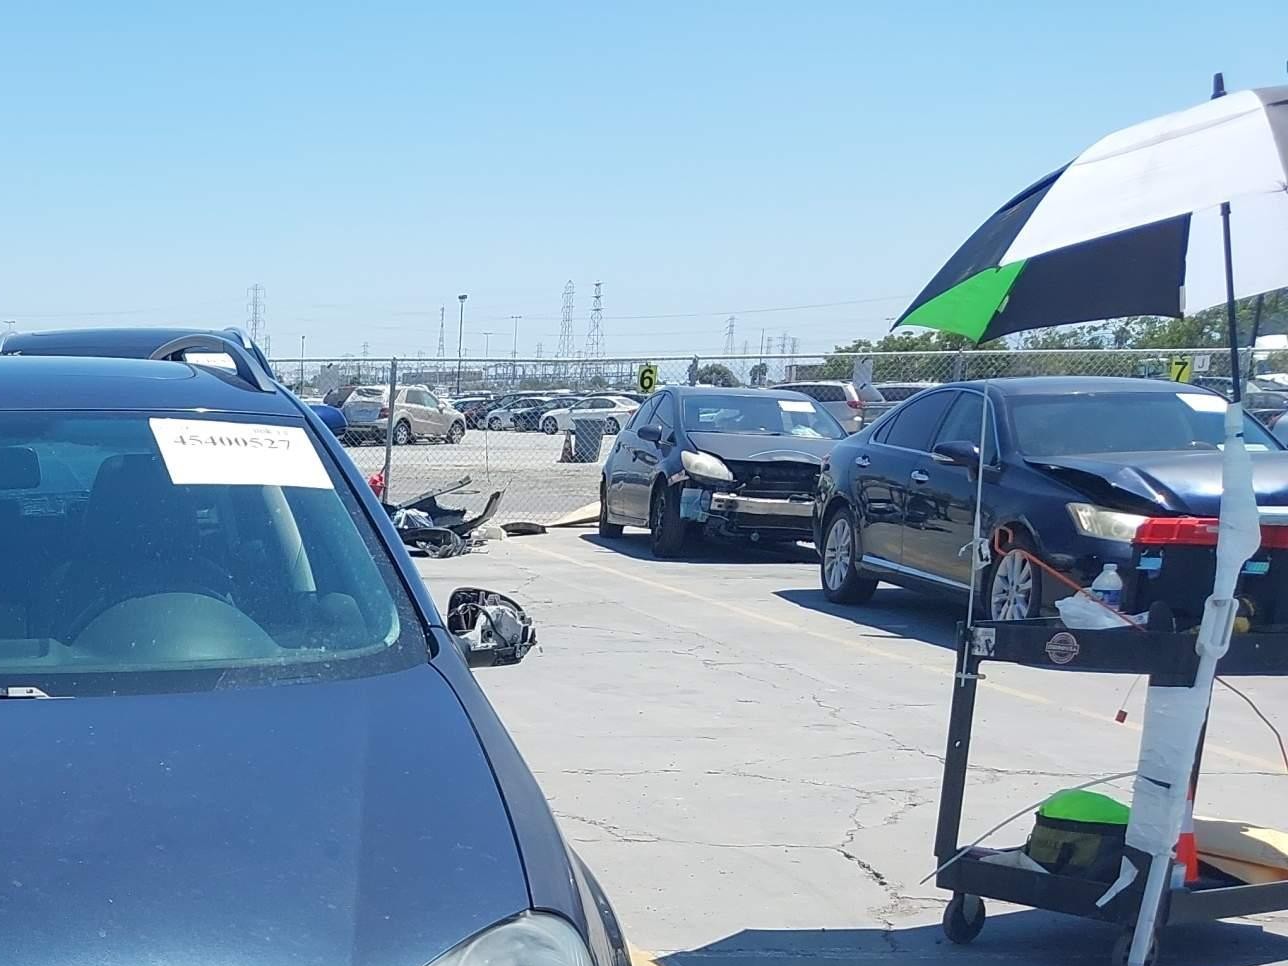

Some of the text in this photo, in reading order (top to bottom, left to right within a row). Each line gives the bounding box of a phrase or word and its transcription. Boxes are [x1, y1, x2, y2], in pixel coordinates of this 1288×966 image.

[640, 368, 654, 390] 6
[1175, 361, 1188, 382] 7
[173, 434, 291, 450] 45400527
